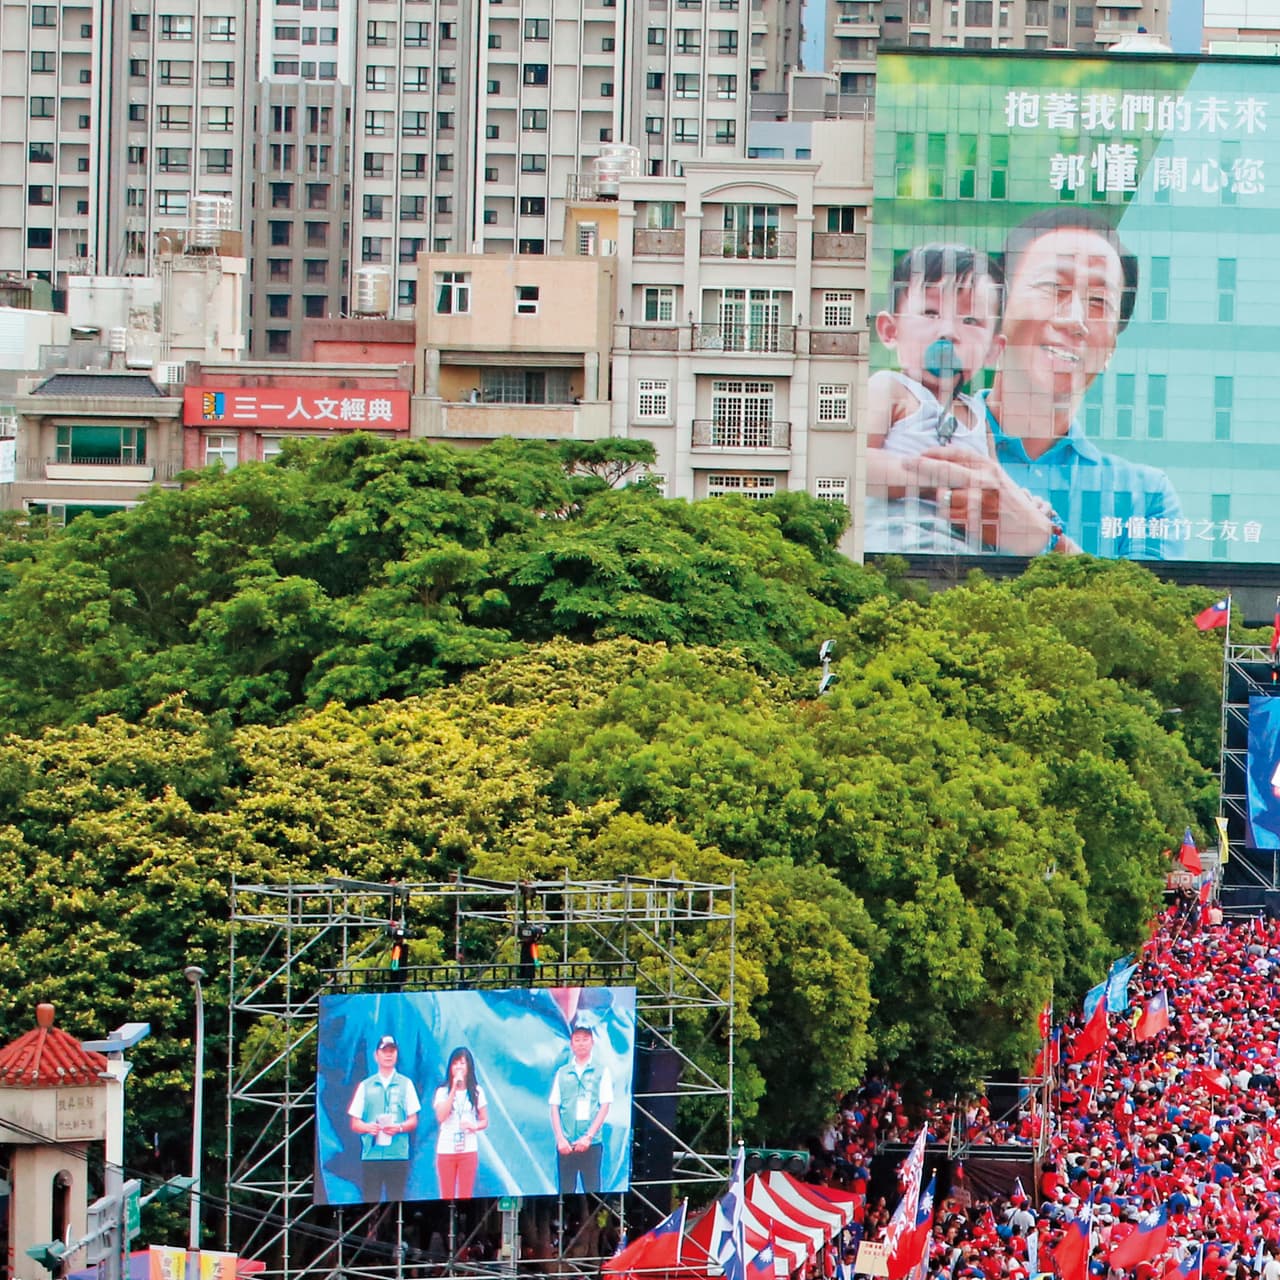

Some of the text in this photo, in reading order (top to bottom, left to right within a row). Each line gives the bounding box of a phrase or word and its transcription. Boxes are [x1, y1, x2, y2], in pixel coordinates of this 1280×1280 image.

[1004, 90, 1268, 134] 抱著我們的未來
[233, 396, 394, 422] 三一人文經典
[1101, 516, 1263, 545] 郭懂新竹之友會
